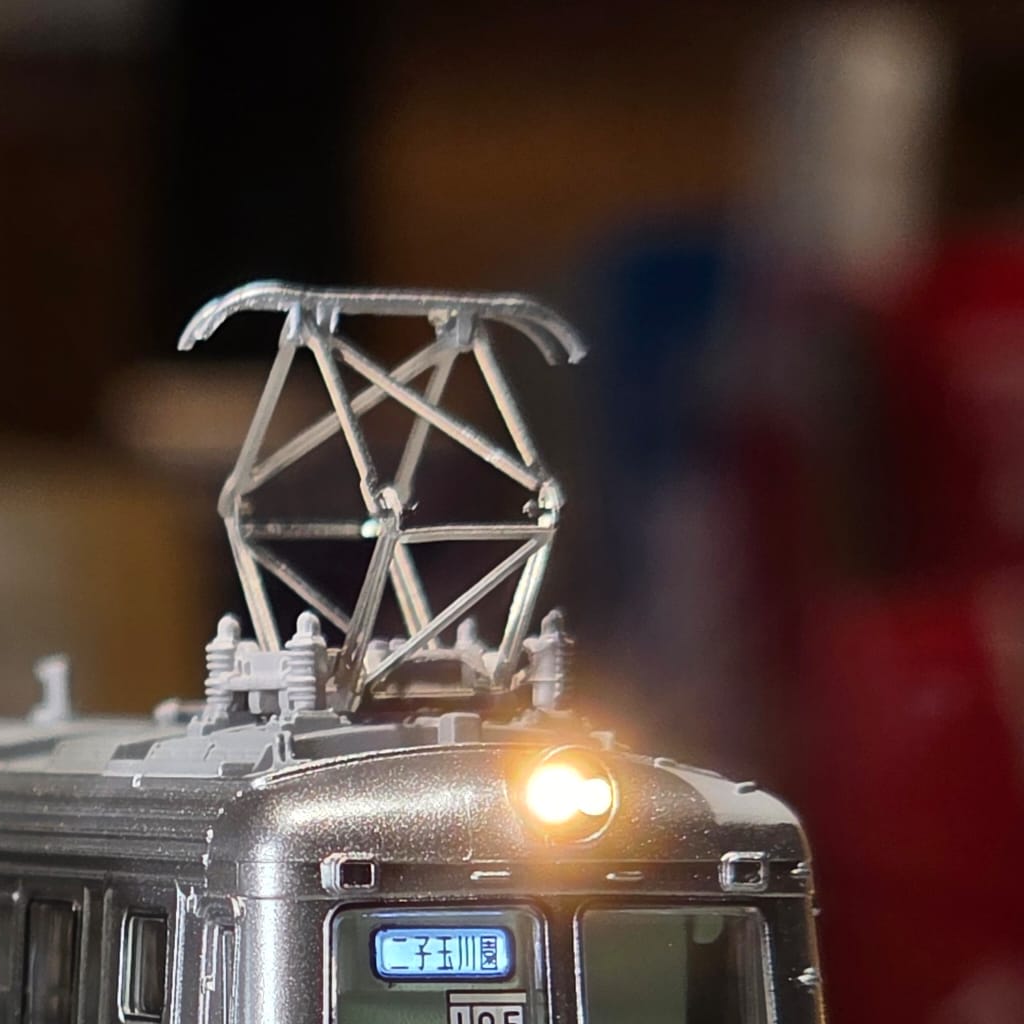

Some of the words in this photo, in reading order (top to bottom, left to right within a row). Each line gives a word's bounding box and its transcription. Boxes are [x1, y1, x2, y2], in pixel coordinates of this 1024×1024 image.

[390, 935, 498, 971] 二子玉川園
